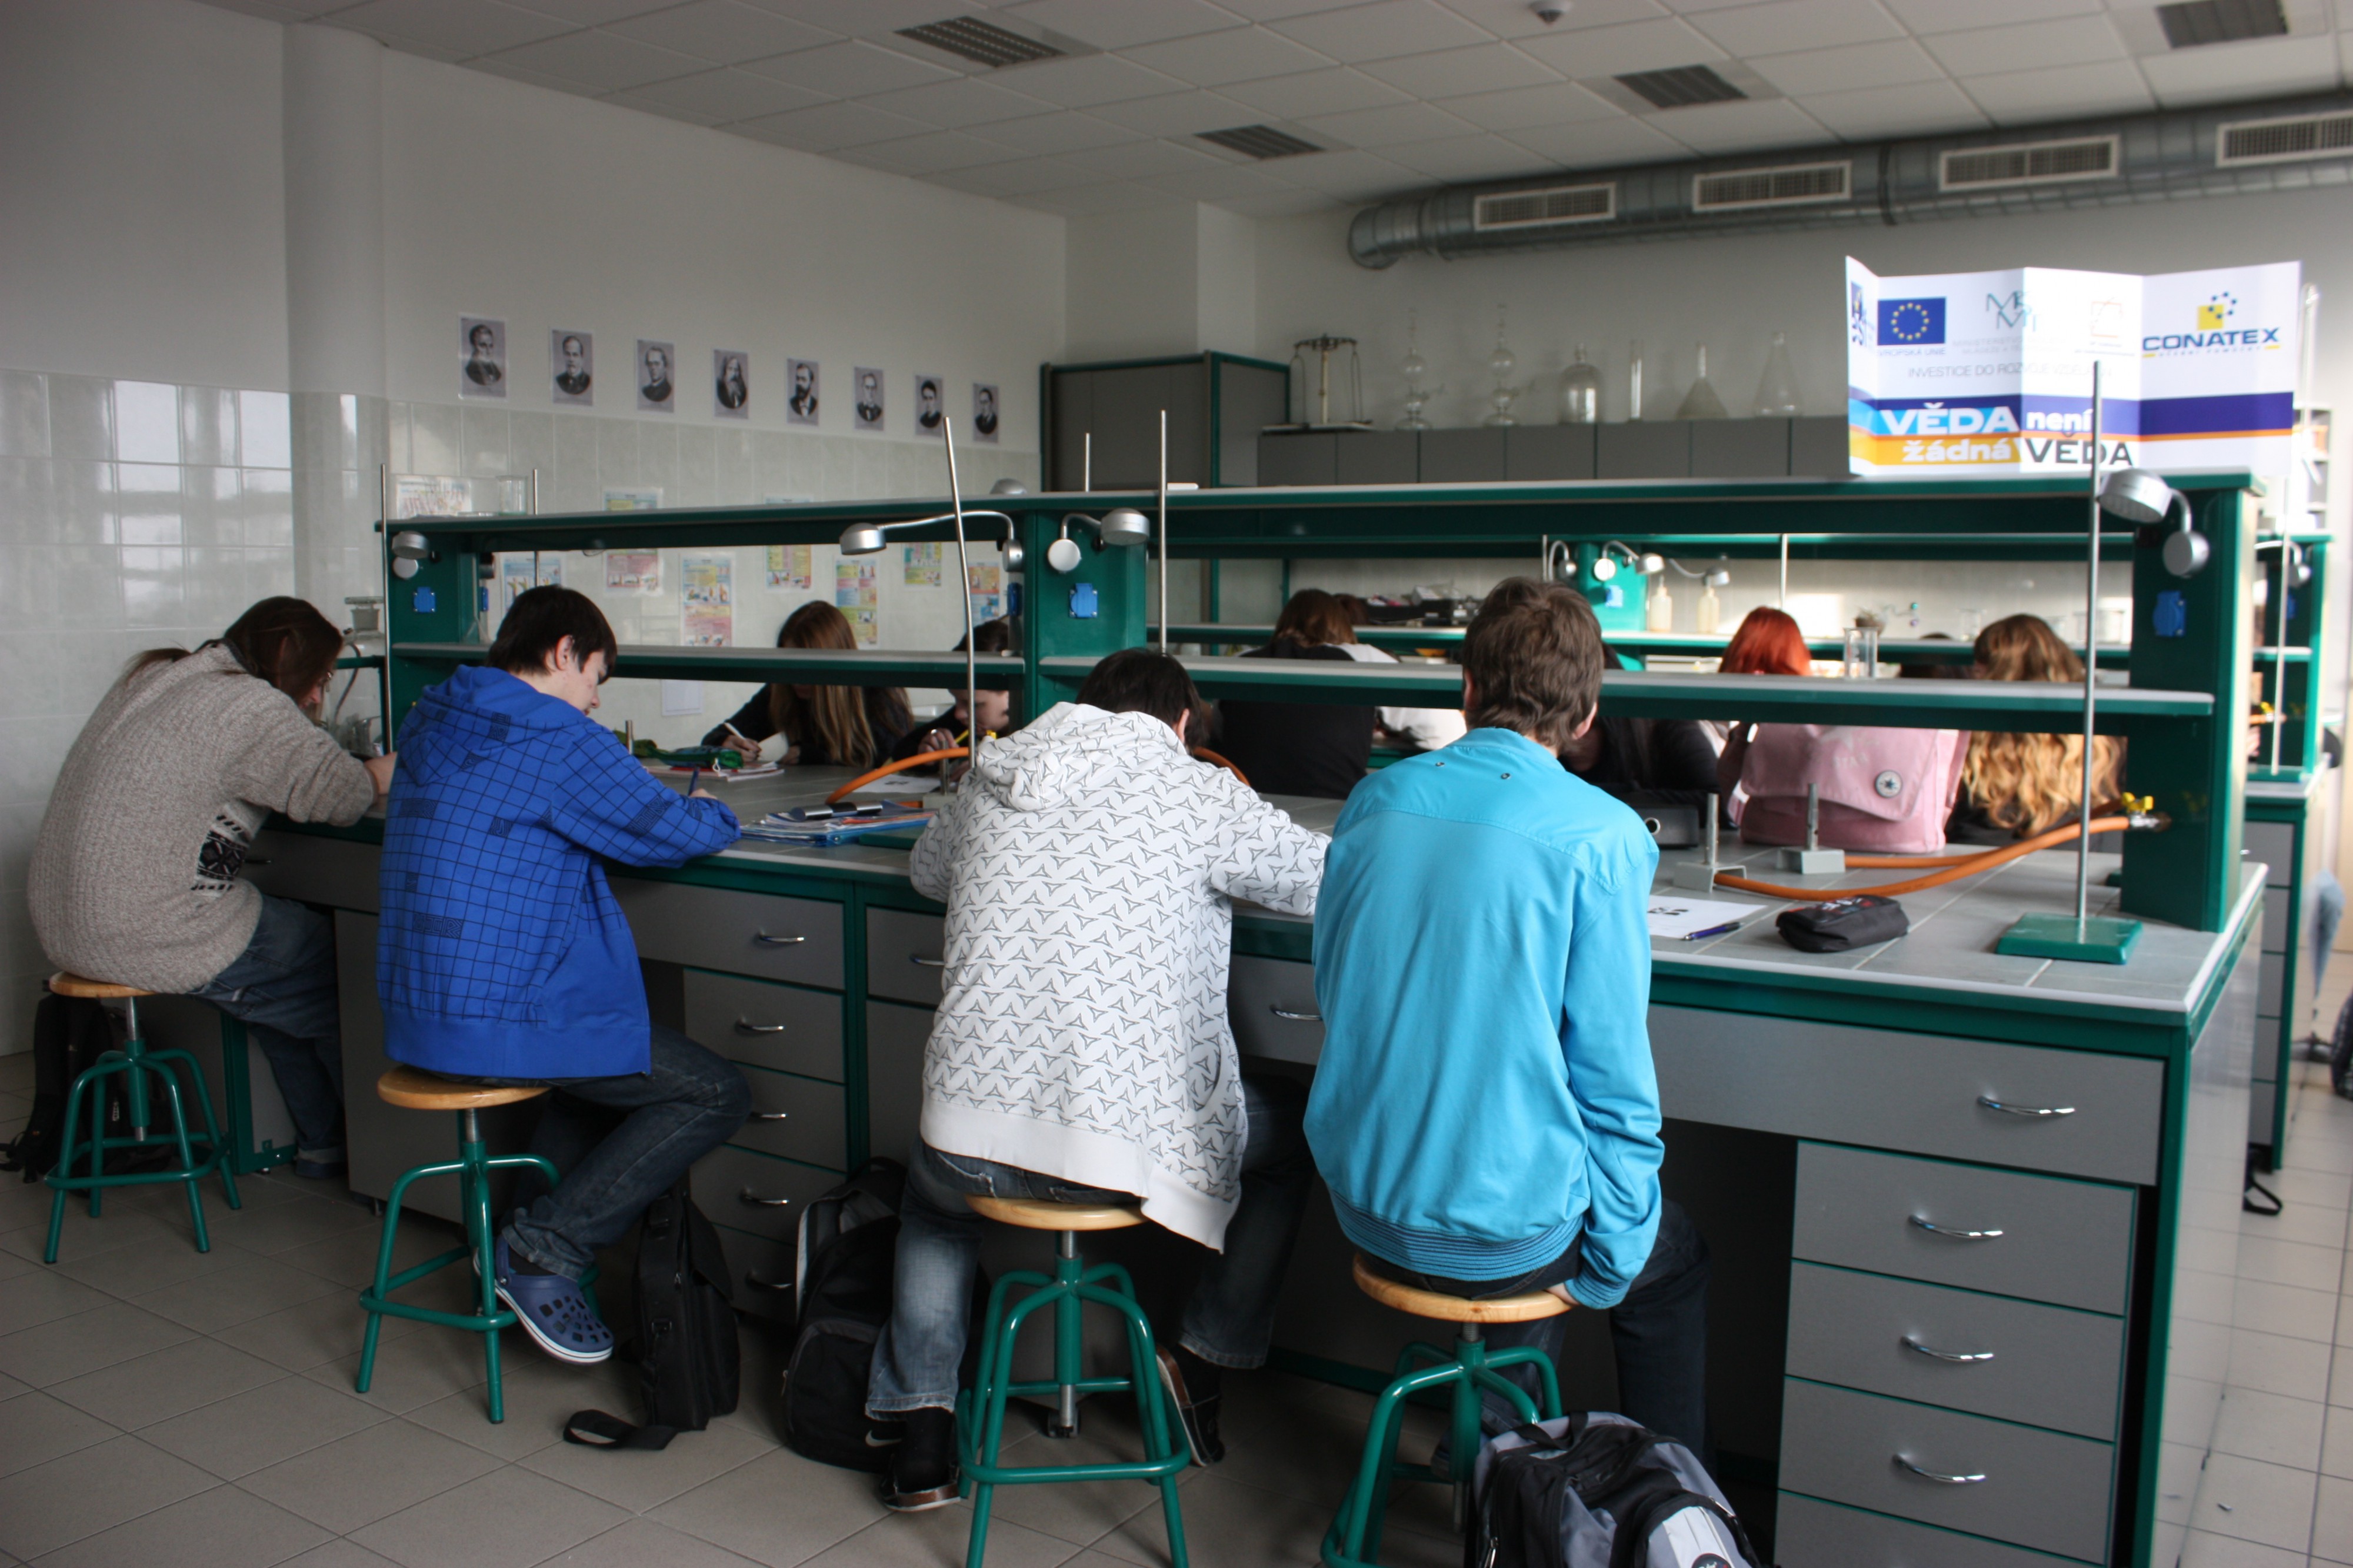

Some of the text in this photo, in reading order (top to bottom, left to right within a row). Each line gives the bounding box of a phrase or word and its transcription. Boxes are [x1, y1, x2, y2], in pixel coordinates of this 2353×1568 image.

[2143, 328, 2279, 351] CONATEX
[1908, 365, 1972, 378] INVESTICE
[1975, 363, 1995, 376] DO
[1880, 402, 2094, 435] VĚDA není
[1902, 438, 2012, 463] žádná
